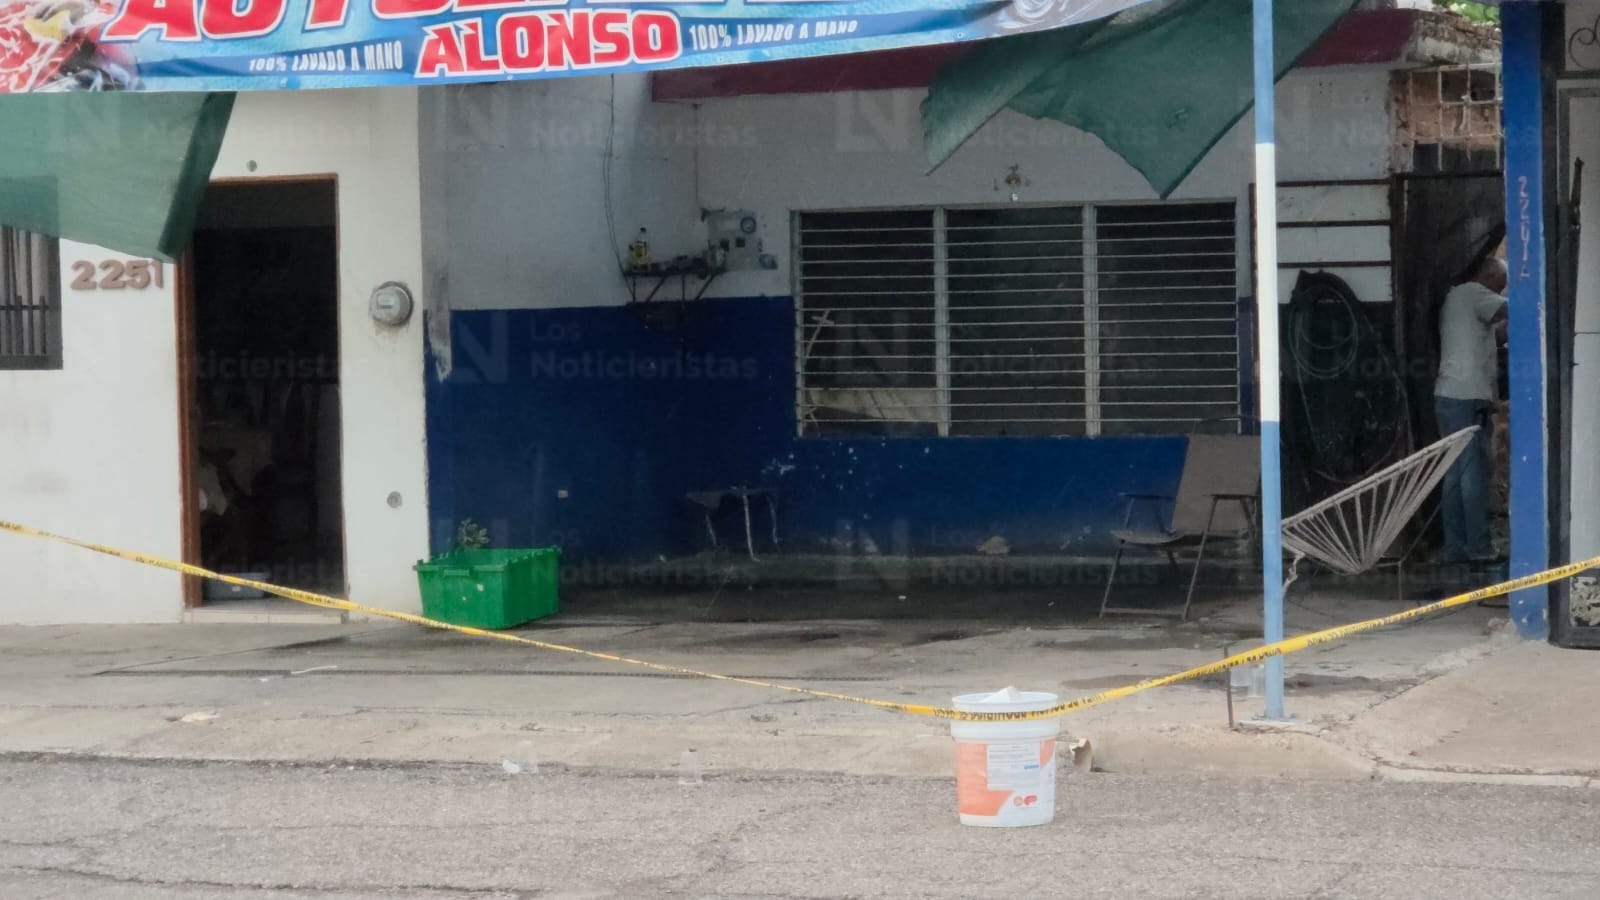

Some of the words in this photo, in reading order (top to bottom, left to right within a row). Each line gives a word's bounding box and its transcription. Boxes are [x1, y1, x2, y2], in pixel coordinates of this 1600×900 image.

[414, 9, 680, 78] ALONSO
[689, 24, 731, 50] 100%
[736, 23, 793, 45] LAVADO
[799, 20, 809, 39] A
[815, 20, 858, 38] MANO
[249, 56, 286, 71] 100%
[291, 49, 345, 71] LAVADO
[351, 47, 360, 71] A
[364, 40, 402, 71] MANO
[70, 258, 164, 290] 2251
